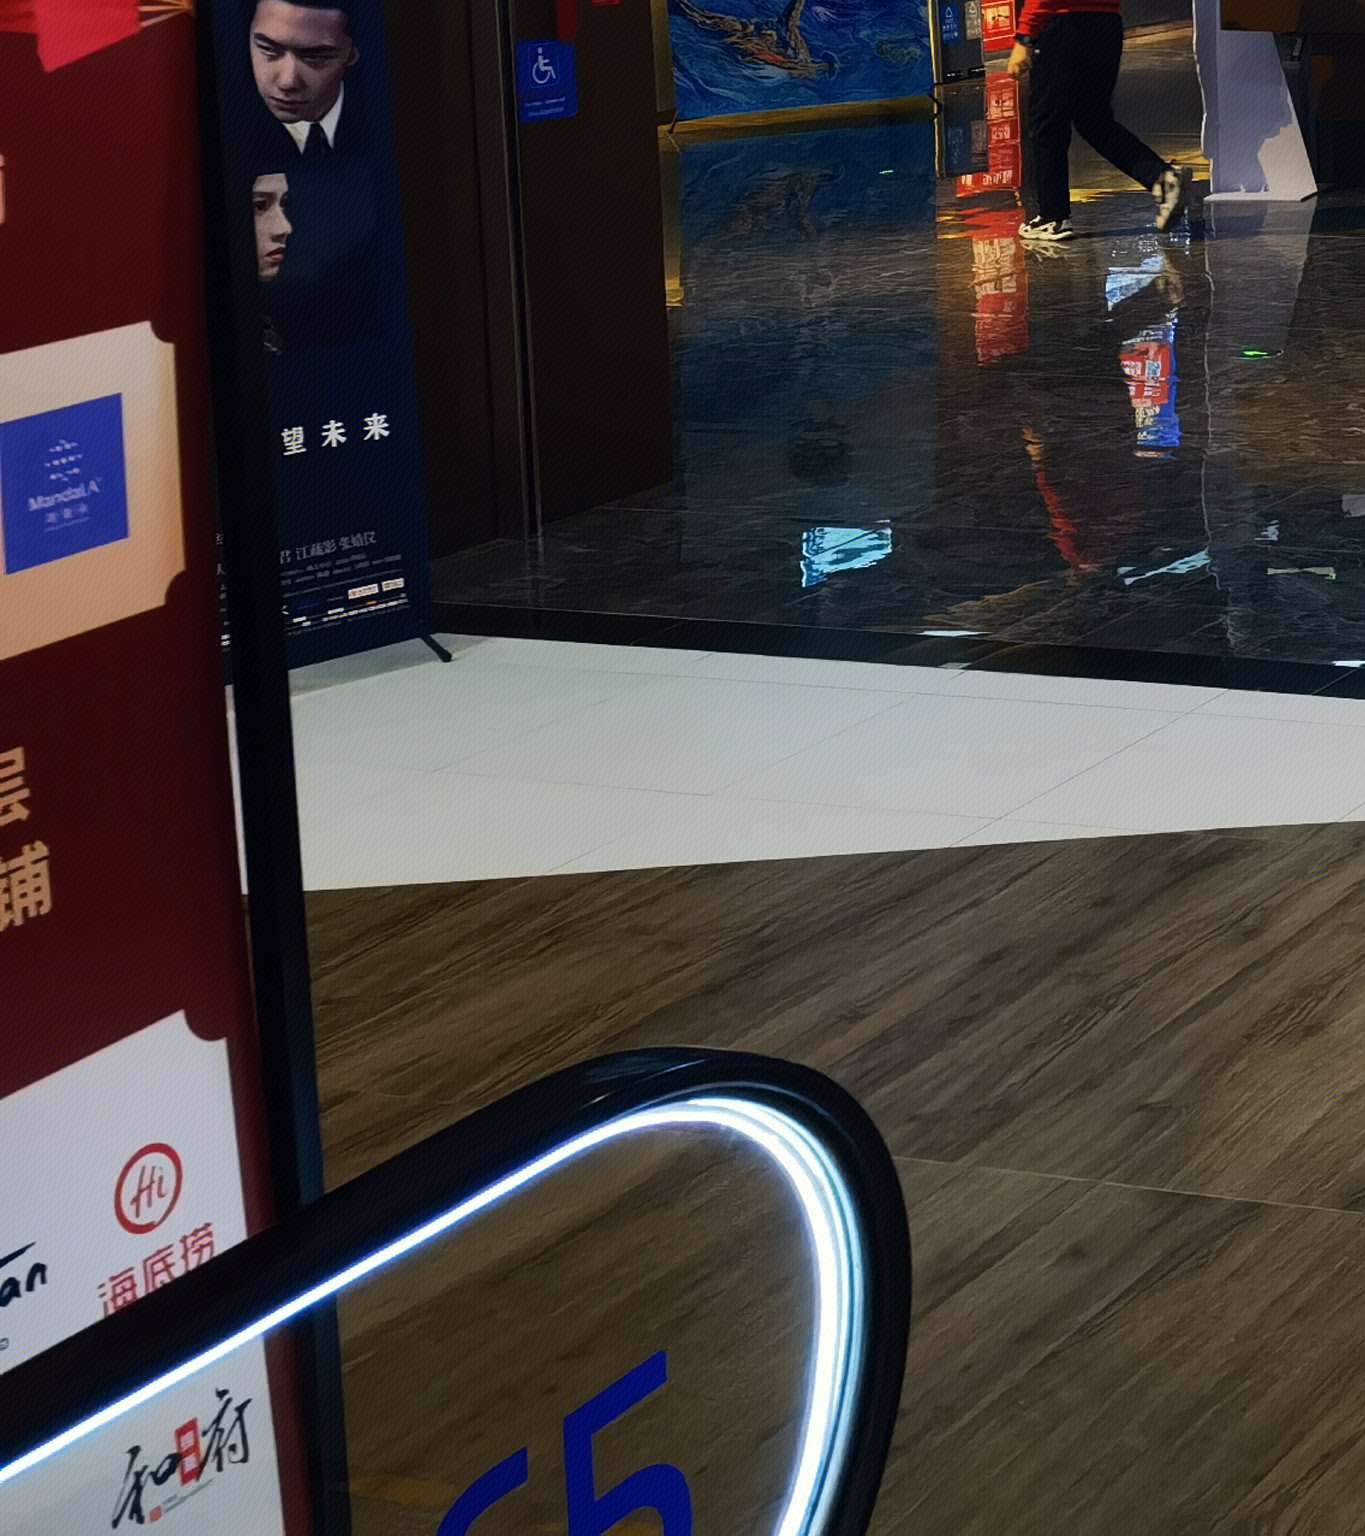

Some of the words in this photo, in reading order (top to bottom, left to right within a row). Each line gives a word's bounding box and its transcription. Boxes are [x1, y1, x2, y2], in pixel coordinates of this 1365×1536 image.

[281, 412, 390, 456] 望未来
[130, 1165, 168, 1219] Hi
